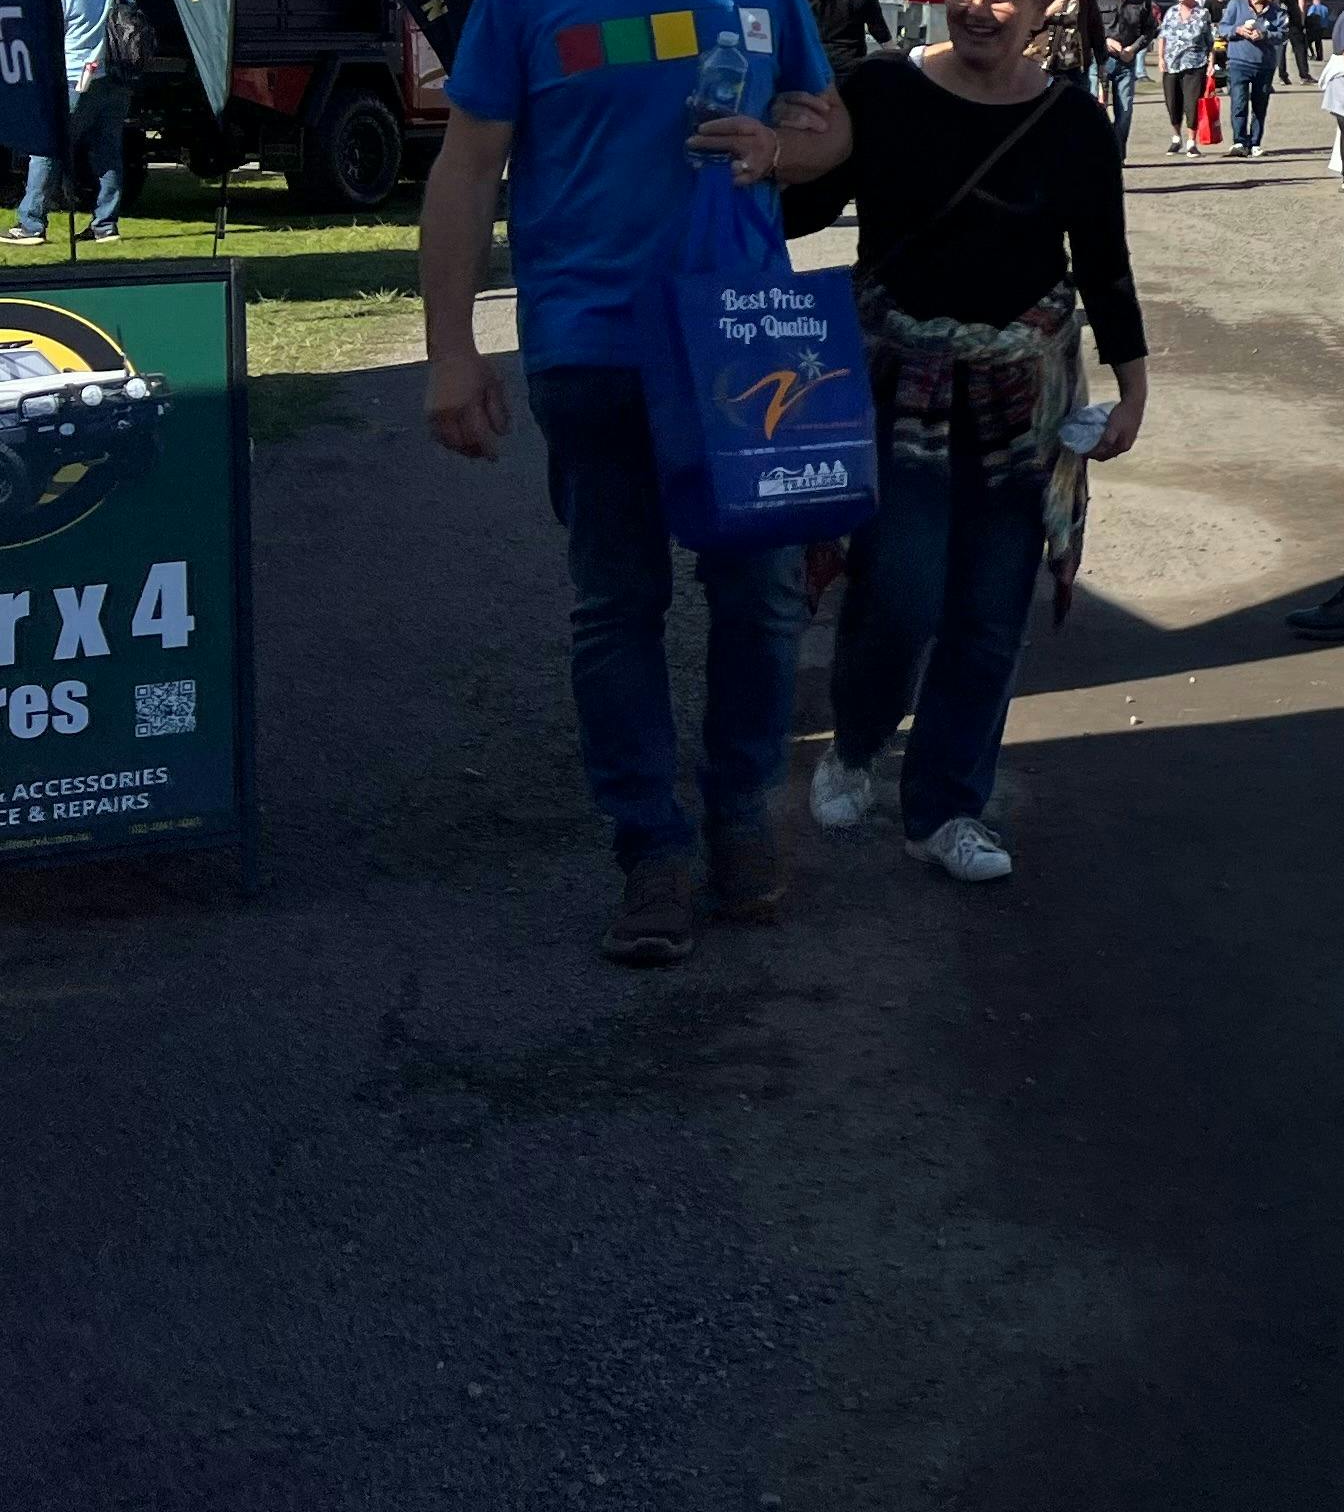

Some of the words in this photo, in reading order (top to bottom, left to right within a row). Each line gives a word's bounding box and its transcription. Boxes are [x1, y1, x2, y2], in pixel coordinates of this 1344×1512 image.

[720, 287, 768, 311] Best
[768, 287, 816, 310] Price
[718, 315, 758, 345] Top
[759, 314, 828, 342] Quality
[54, 584, 111, 660] x
[130, 560, 196, 649] 4
[11, 767, 169, 803] ACCESSORIES
[27, 805, 47, 823] &
[52, 792, 150, 820] REPAIRS
